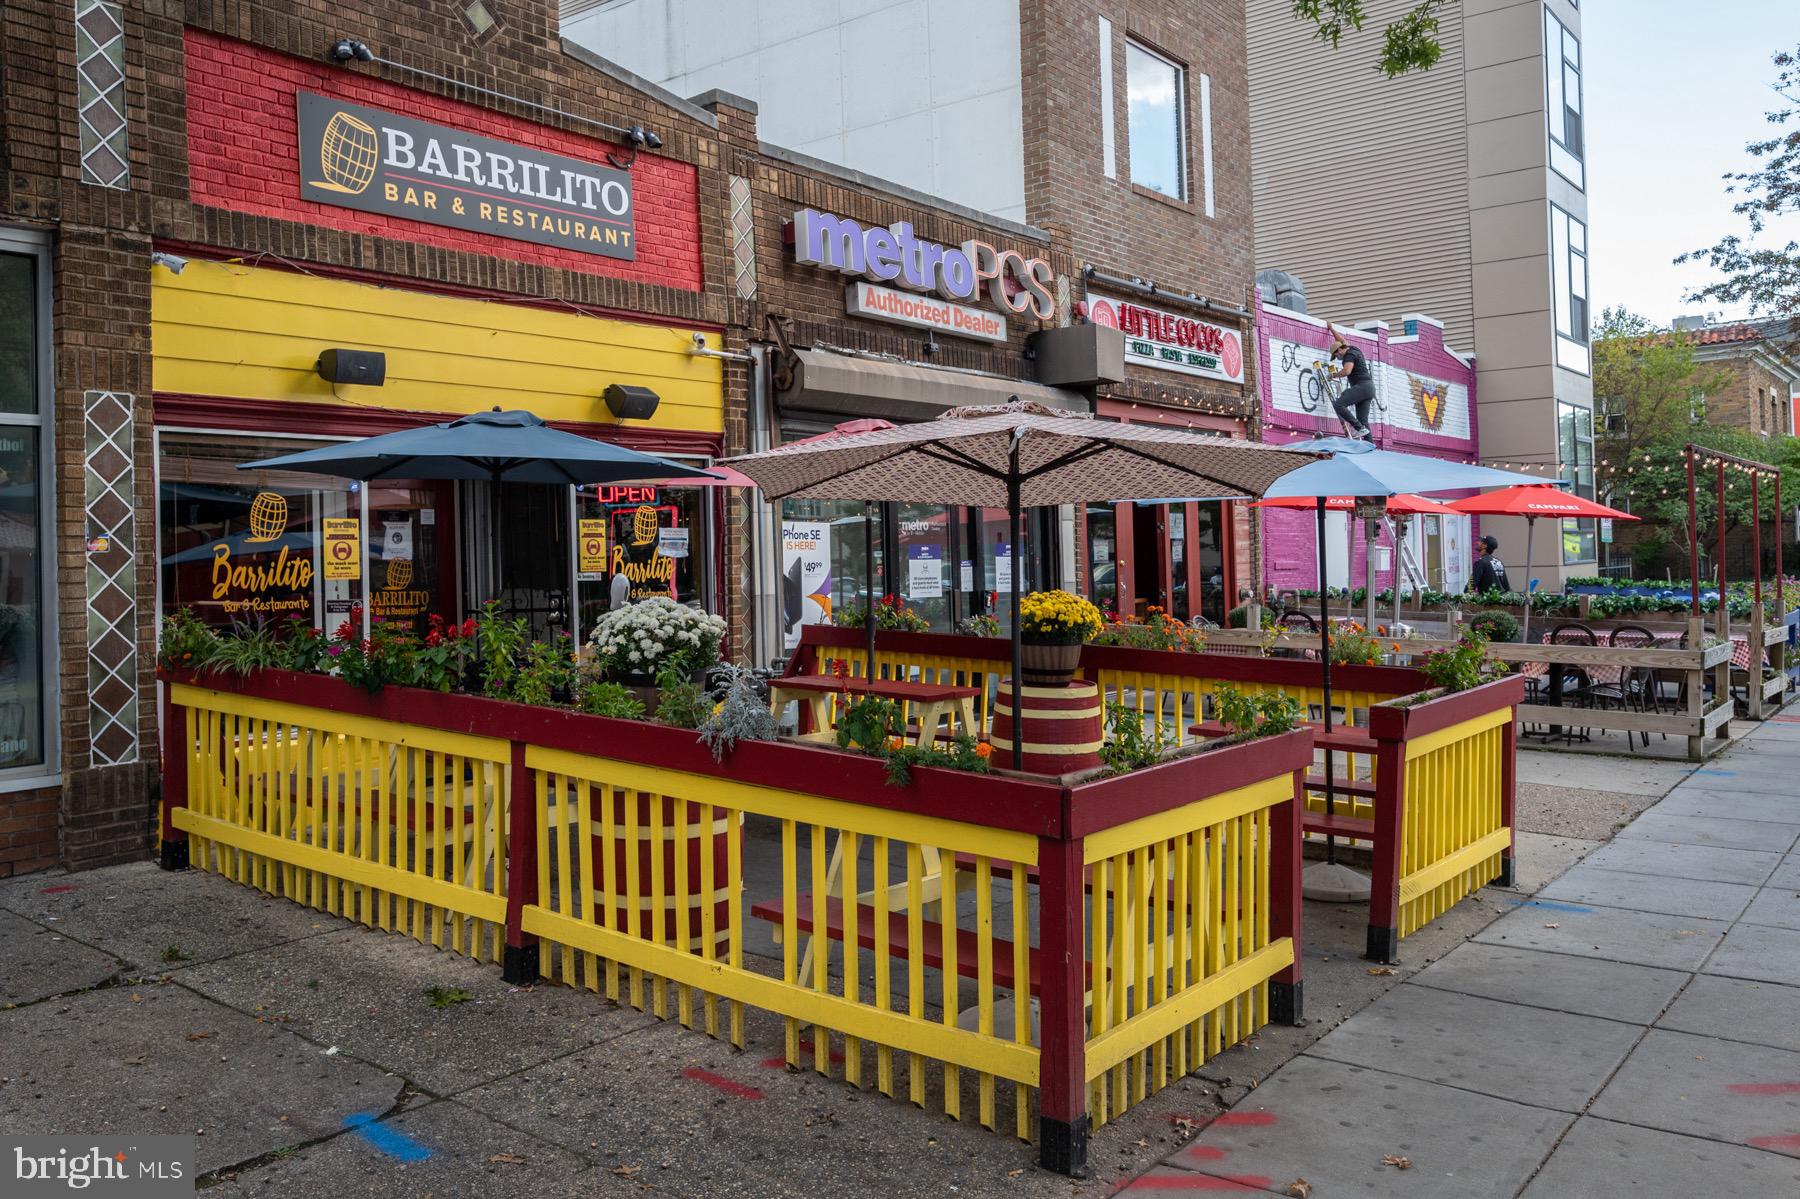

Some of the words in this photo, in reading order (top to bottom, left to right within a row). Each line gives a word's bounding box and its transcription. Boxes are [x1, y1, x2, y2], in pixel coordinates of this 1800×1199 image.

[382, 127, 630, 216] BARRILITO
[384, 182, 438, 210] BAR
[451, 196, 466, 216] &
[480, 202, 632, 249] RESTAURANT
[865, 287, 950, 326] Authorized
[953, 307, 1000, 337] Dealer
[1118, 302, 1177, 344] LITTLE
[1132, 340, 1154, 357] PIZZA
[597, 485, 656, 503] OPEN
[1527, 502, 1581, 512] CAMPARI
[810, 529, 821, 540] SE
[902, 519, 929, 532] metro
[786, 541, 793, 550] IS
[795, 541, 817, 550] HERE!
[212, 542, 315, 600] Barrilito
[612, 545, 674, 584] Barrilito
[222, 600, 241, 614] Bar
[252, 596, 310, 612] Restaurante
[369, 591, 429, 608] BARRILITO
